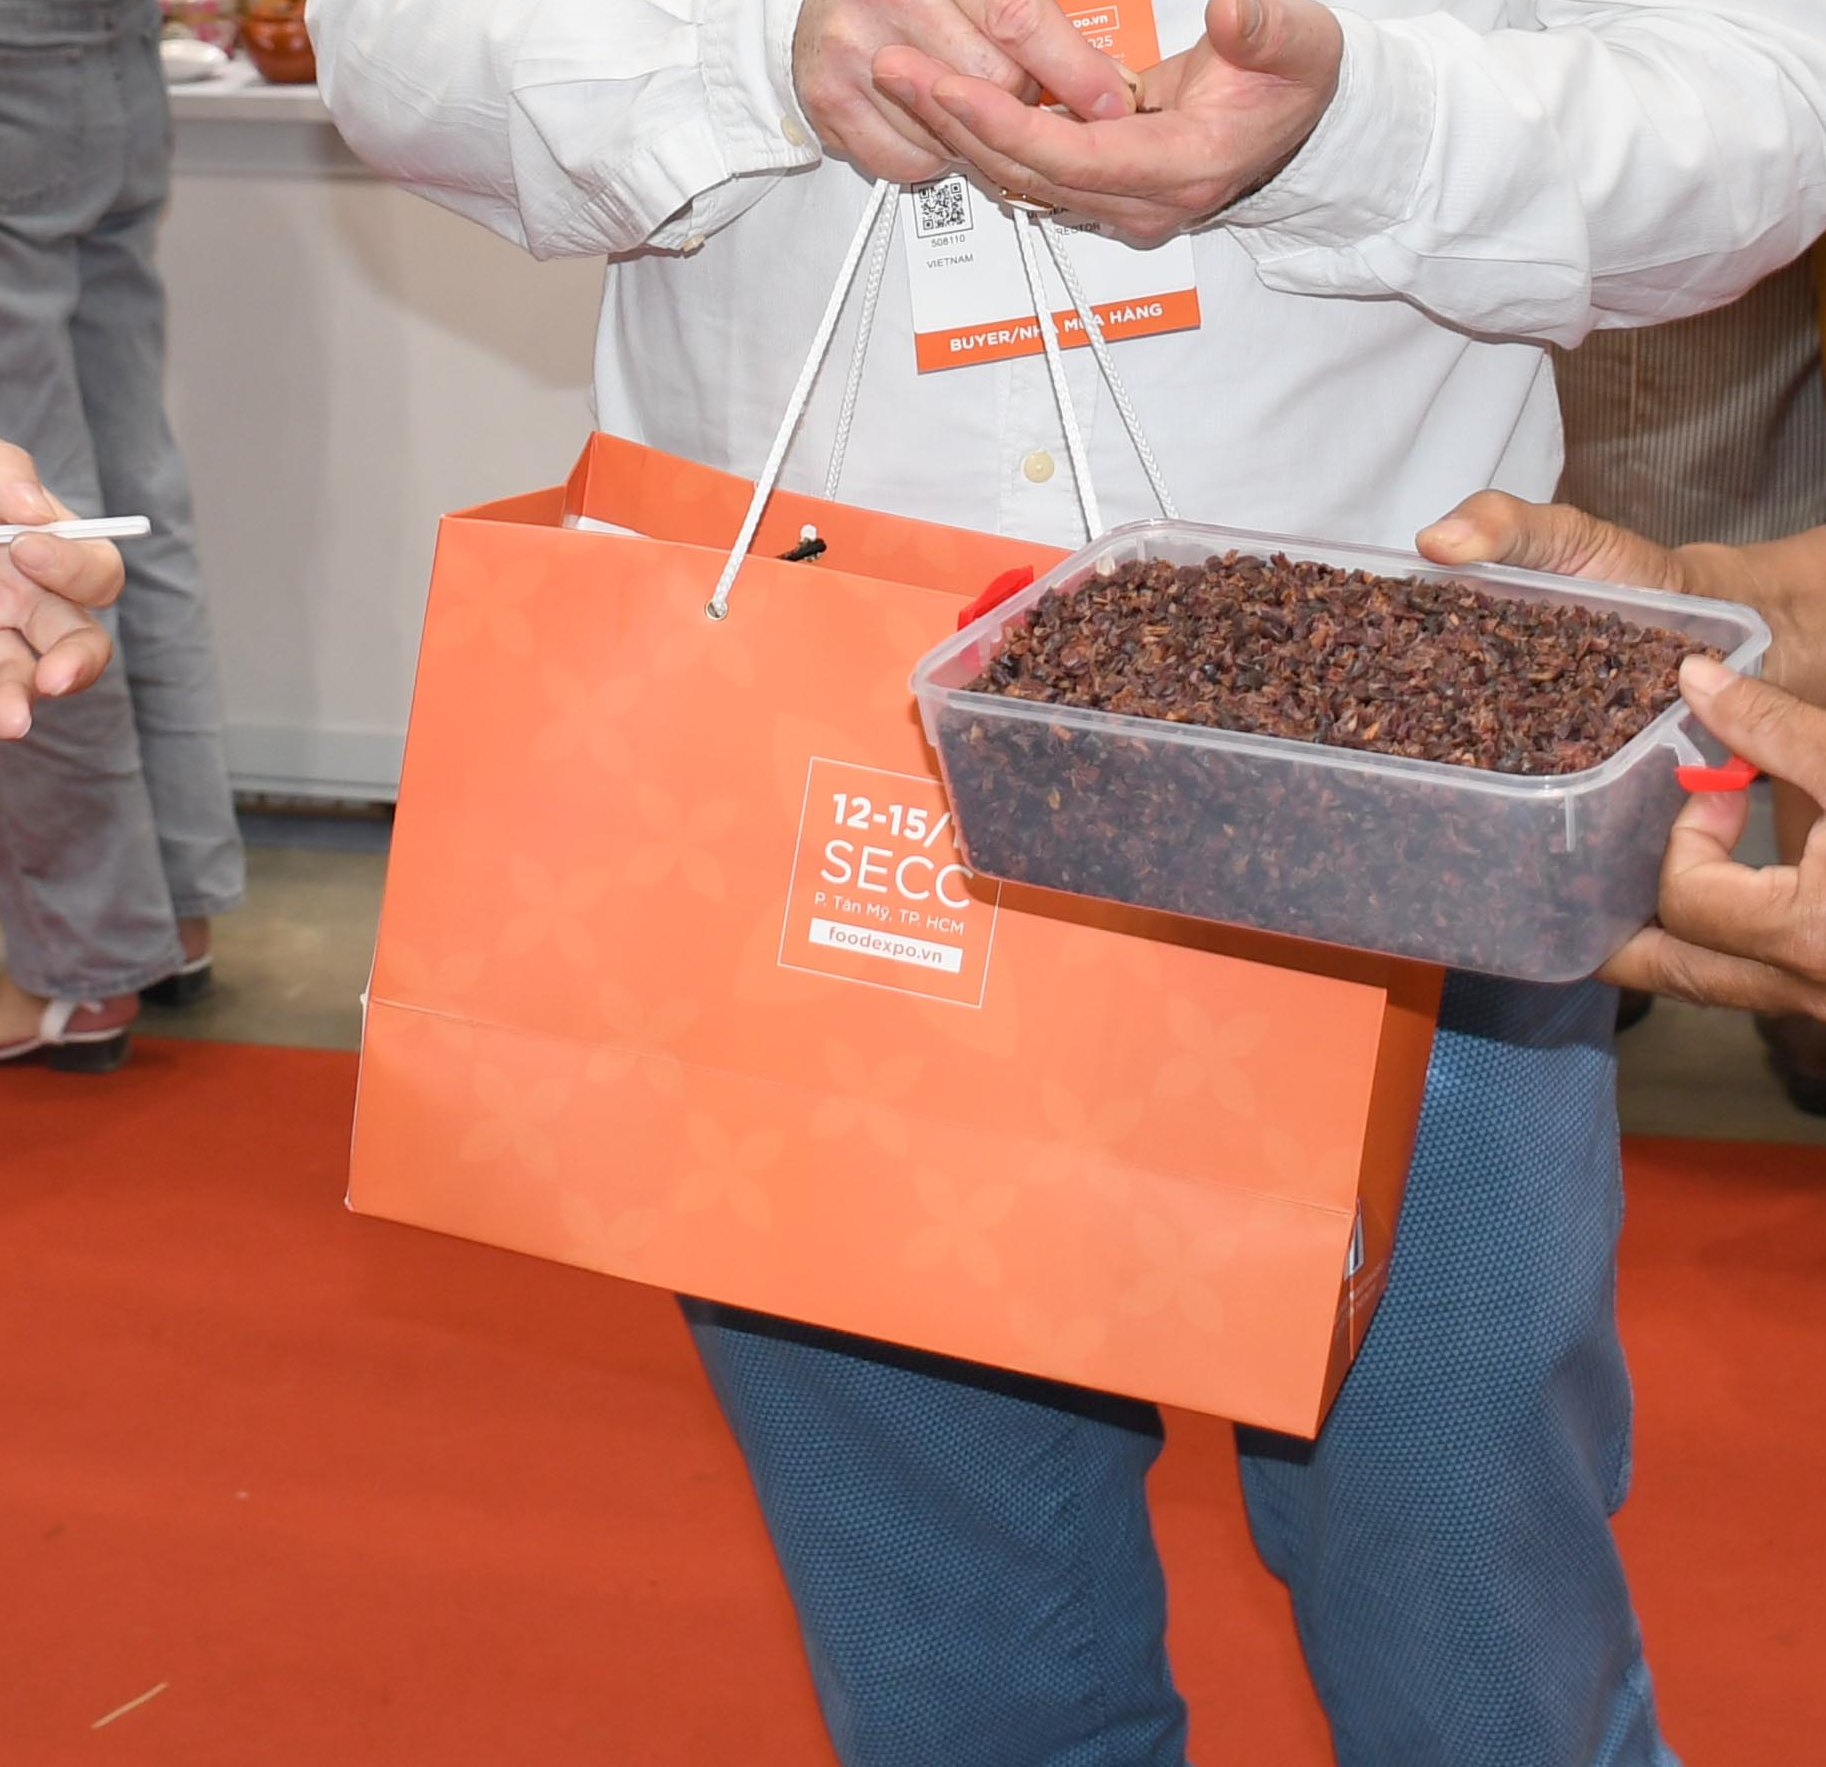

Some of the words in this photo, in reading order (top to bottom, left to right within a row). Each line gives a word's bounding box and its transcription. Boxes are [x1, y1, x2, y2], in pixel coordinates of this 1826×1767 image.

[930, 235, 966, 249] 508110
[926, 253, 975, 270] VIETNAM
[1109, 300, 1164, 326] HÀNG
[820, 838, 975, 910] SECC
[813, 890, 828, 908] P.
[832, 894, 863, 916] Tân
[865, 901, 893, 924] Mỹ,
[898, 908, 922, 928] TP.
[925, 915, 966, 936] HCM
[827, 925, 944, 965] foodexpo.vn
